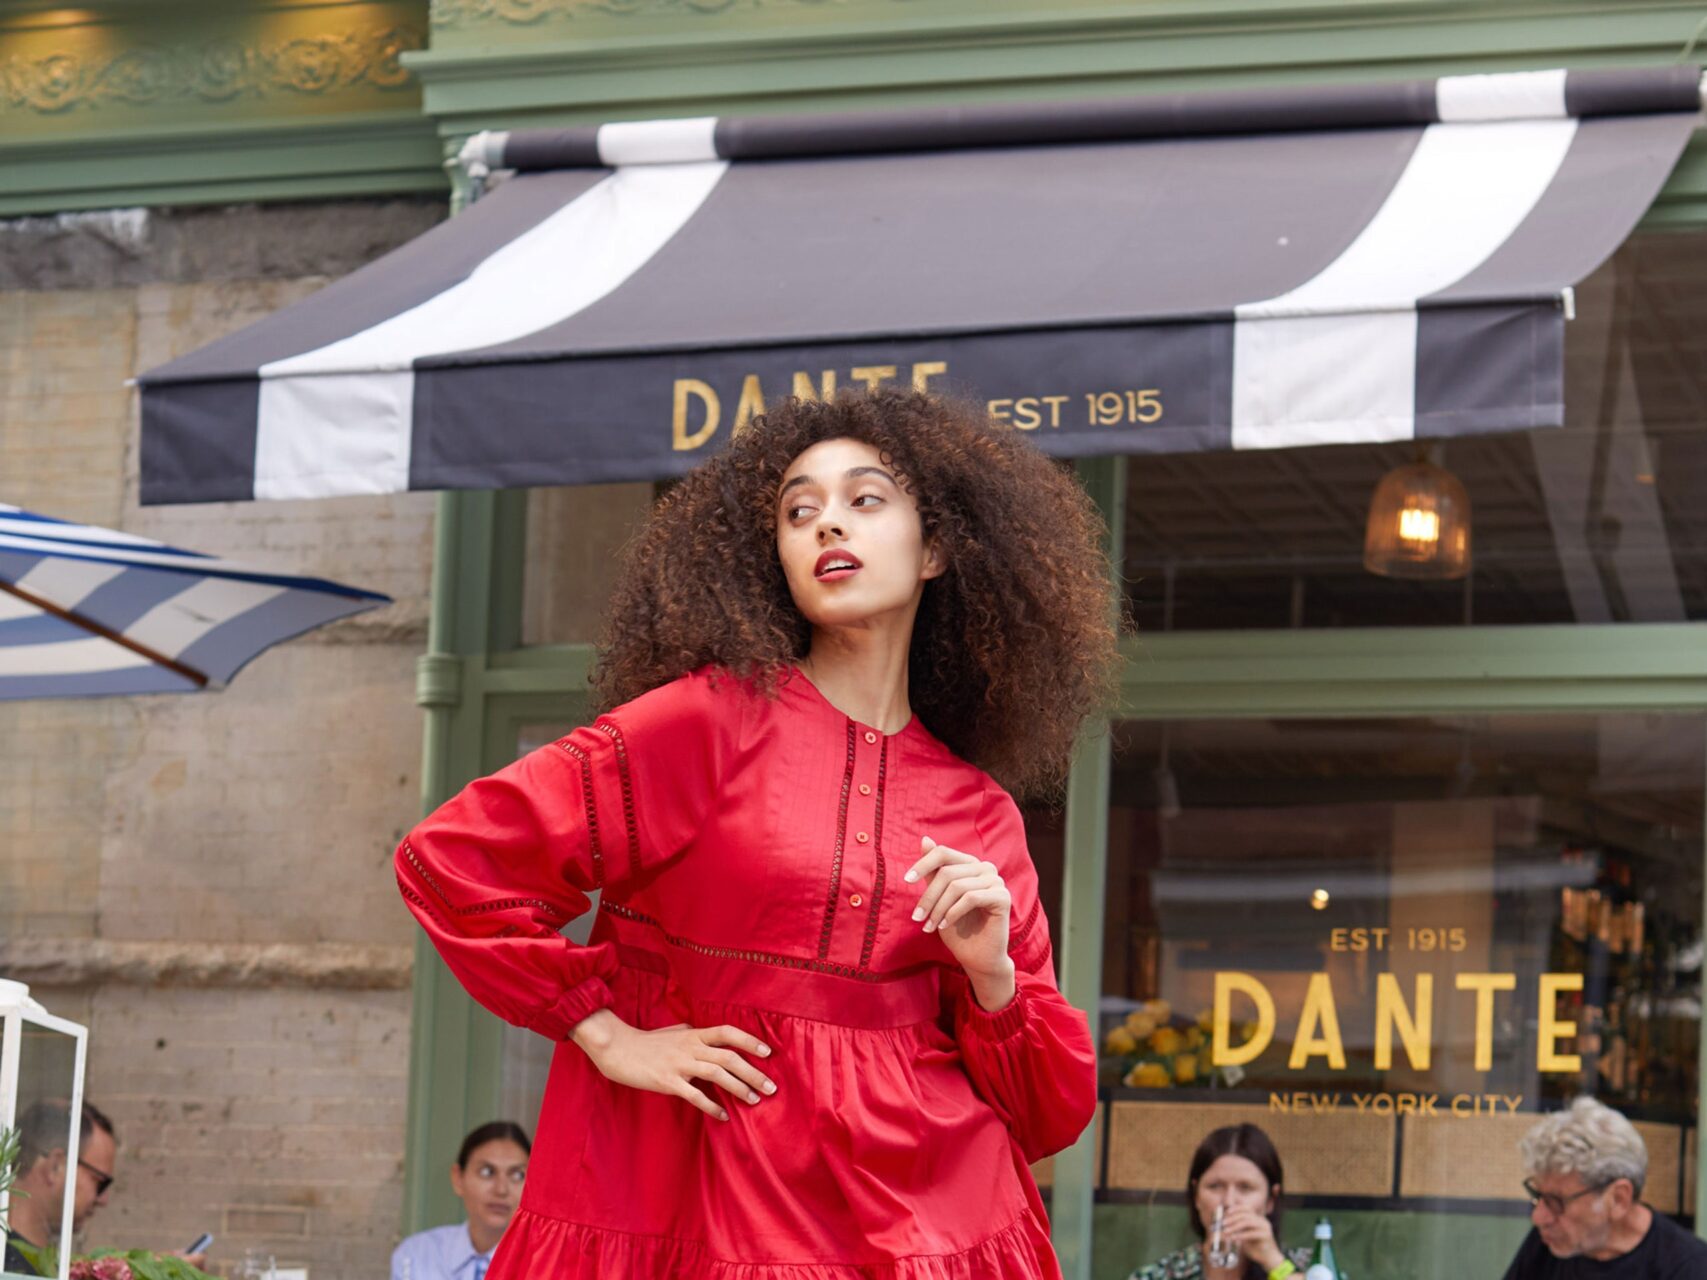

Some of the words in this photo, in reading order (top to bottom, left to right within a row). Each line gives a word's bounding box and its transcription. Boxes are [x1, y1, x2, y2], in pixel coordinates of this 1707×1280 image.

[988, 396, 1070, 430] EST
[1085, 389, 1163, 425] 1915
[1407, 927, 1467, 952] 1915
[1212, 971, 1584, 1072] DANTE
[1269, 1092, 1341, 1115] NEW
[1352, 1092, 1439, 1117] YORK
[1452, 1094, 1522, 1119] CITY
